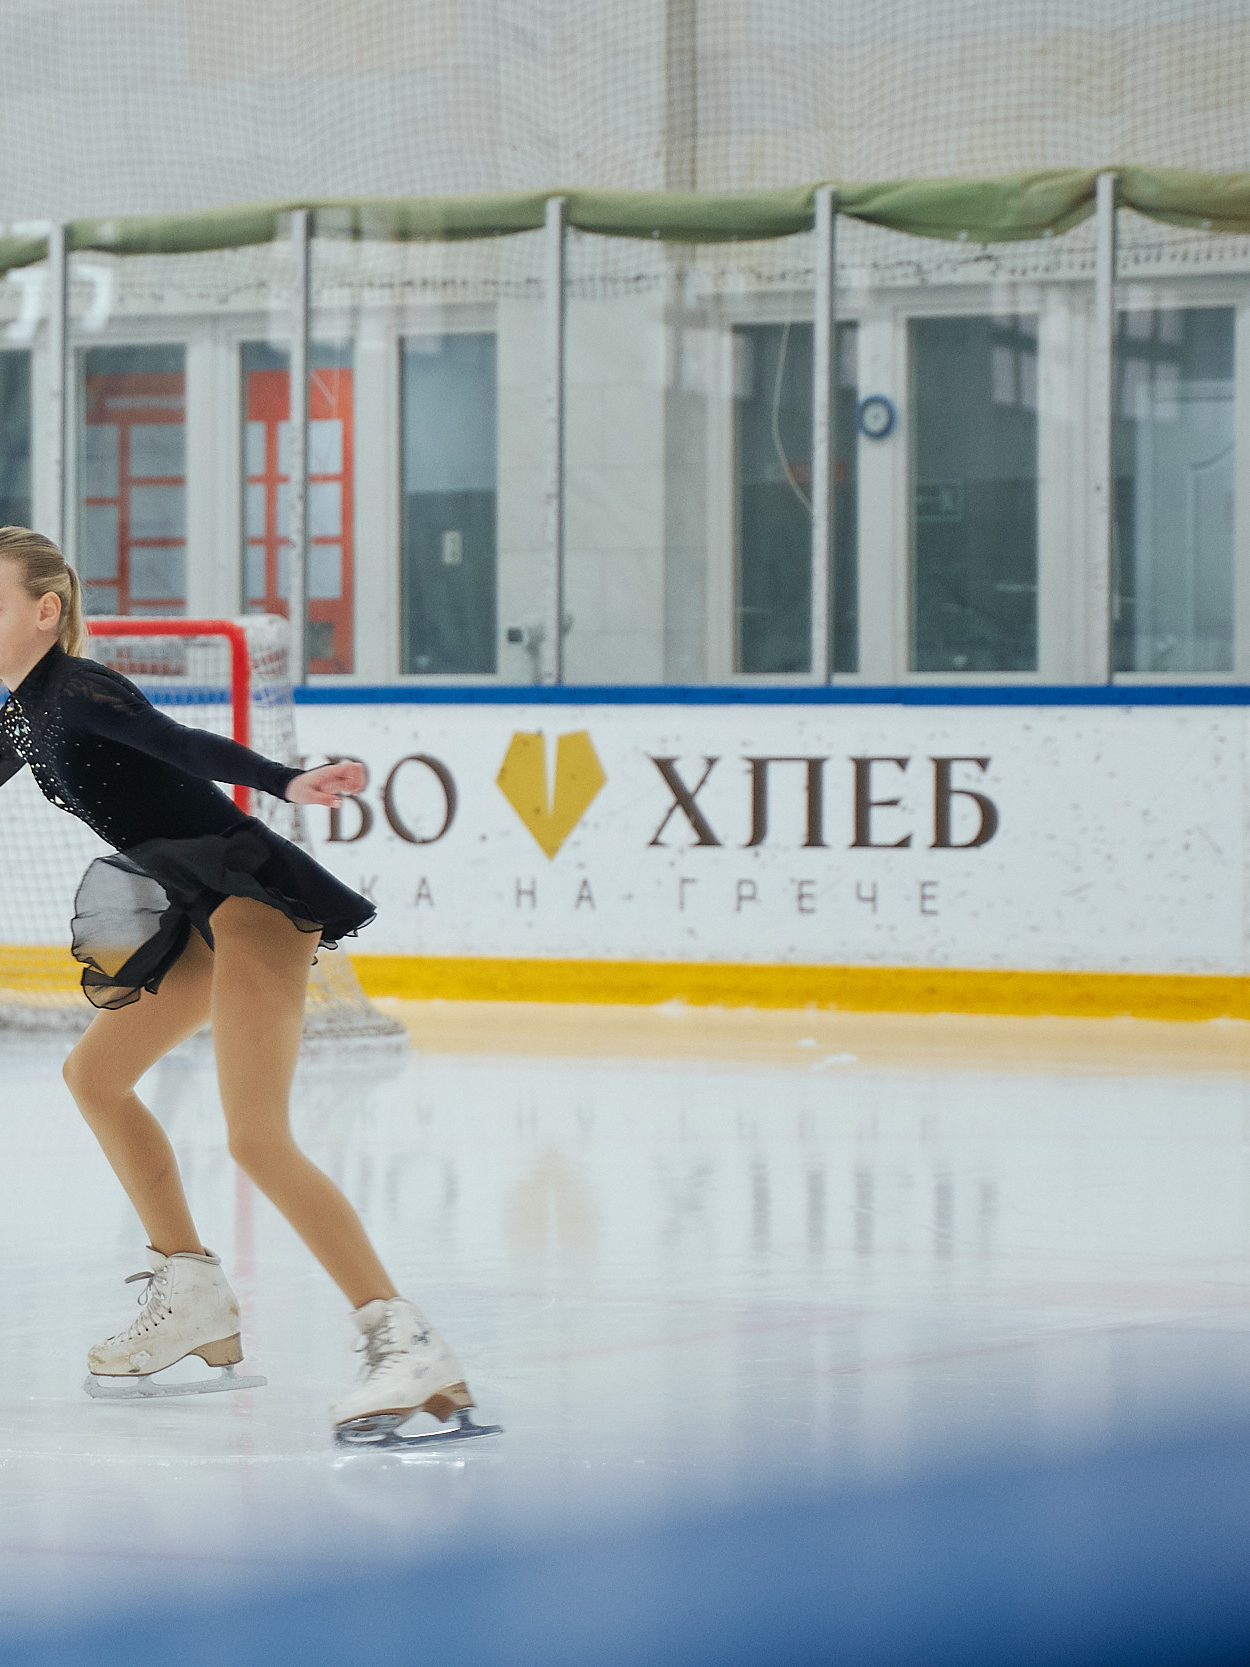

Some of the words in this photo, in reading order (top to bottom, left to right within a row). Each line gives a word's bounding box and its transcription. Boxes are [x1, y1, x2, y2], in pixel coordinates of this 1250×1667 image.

[290, 753, 457, 844] ВО
[648, 755, 1000, 849] ХЛЕБ
[514, 876, 596, 909] НА
[679, 877, 939, 915] ГРЕЧЕ
